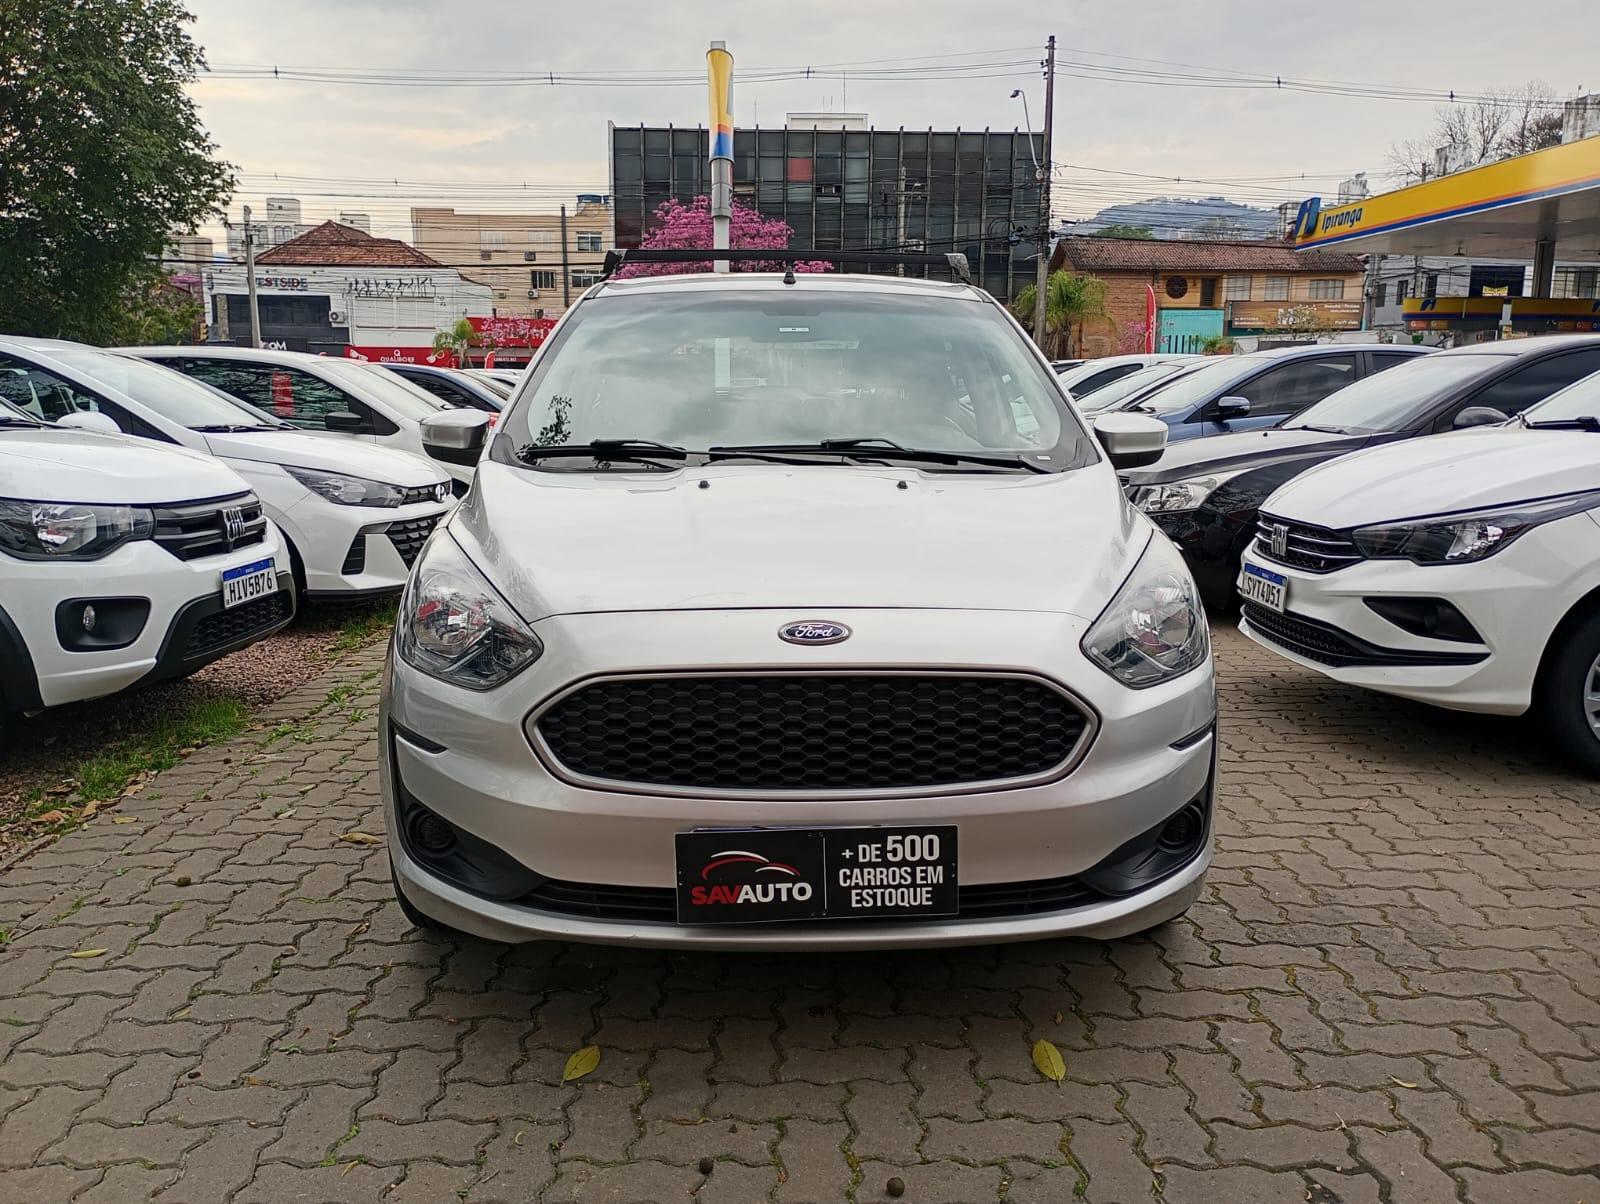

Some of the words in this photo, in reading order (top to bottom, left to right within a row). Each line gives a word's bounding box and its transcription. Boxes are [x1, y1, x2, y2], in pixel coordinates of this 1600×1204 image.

[1322, 208, 1363, 234] Ipiranga
[228, 571, 273, 604] HIV5B76
[1246, 576, 1281, 608] SYT4D51
[795, 624, 834, 637] Ford
[858, 844, 882, 863] DE
[886, 834, 940, 862] 500
[838, 868, 912, 887] CARROS
[916, 866, 944, 885] EM
[691, 882, 813, 905] SAVAUTO
[851, 887, 933, 908] ESTOQUE
